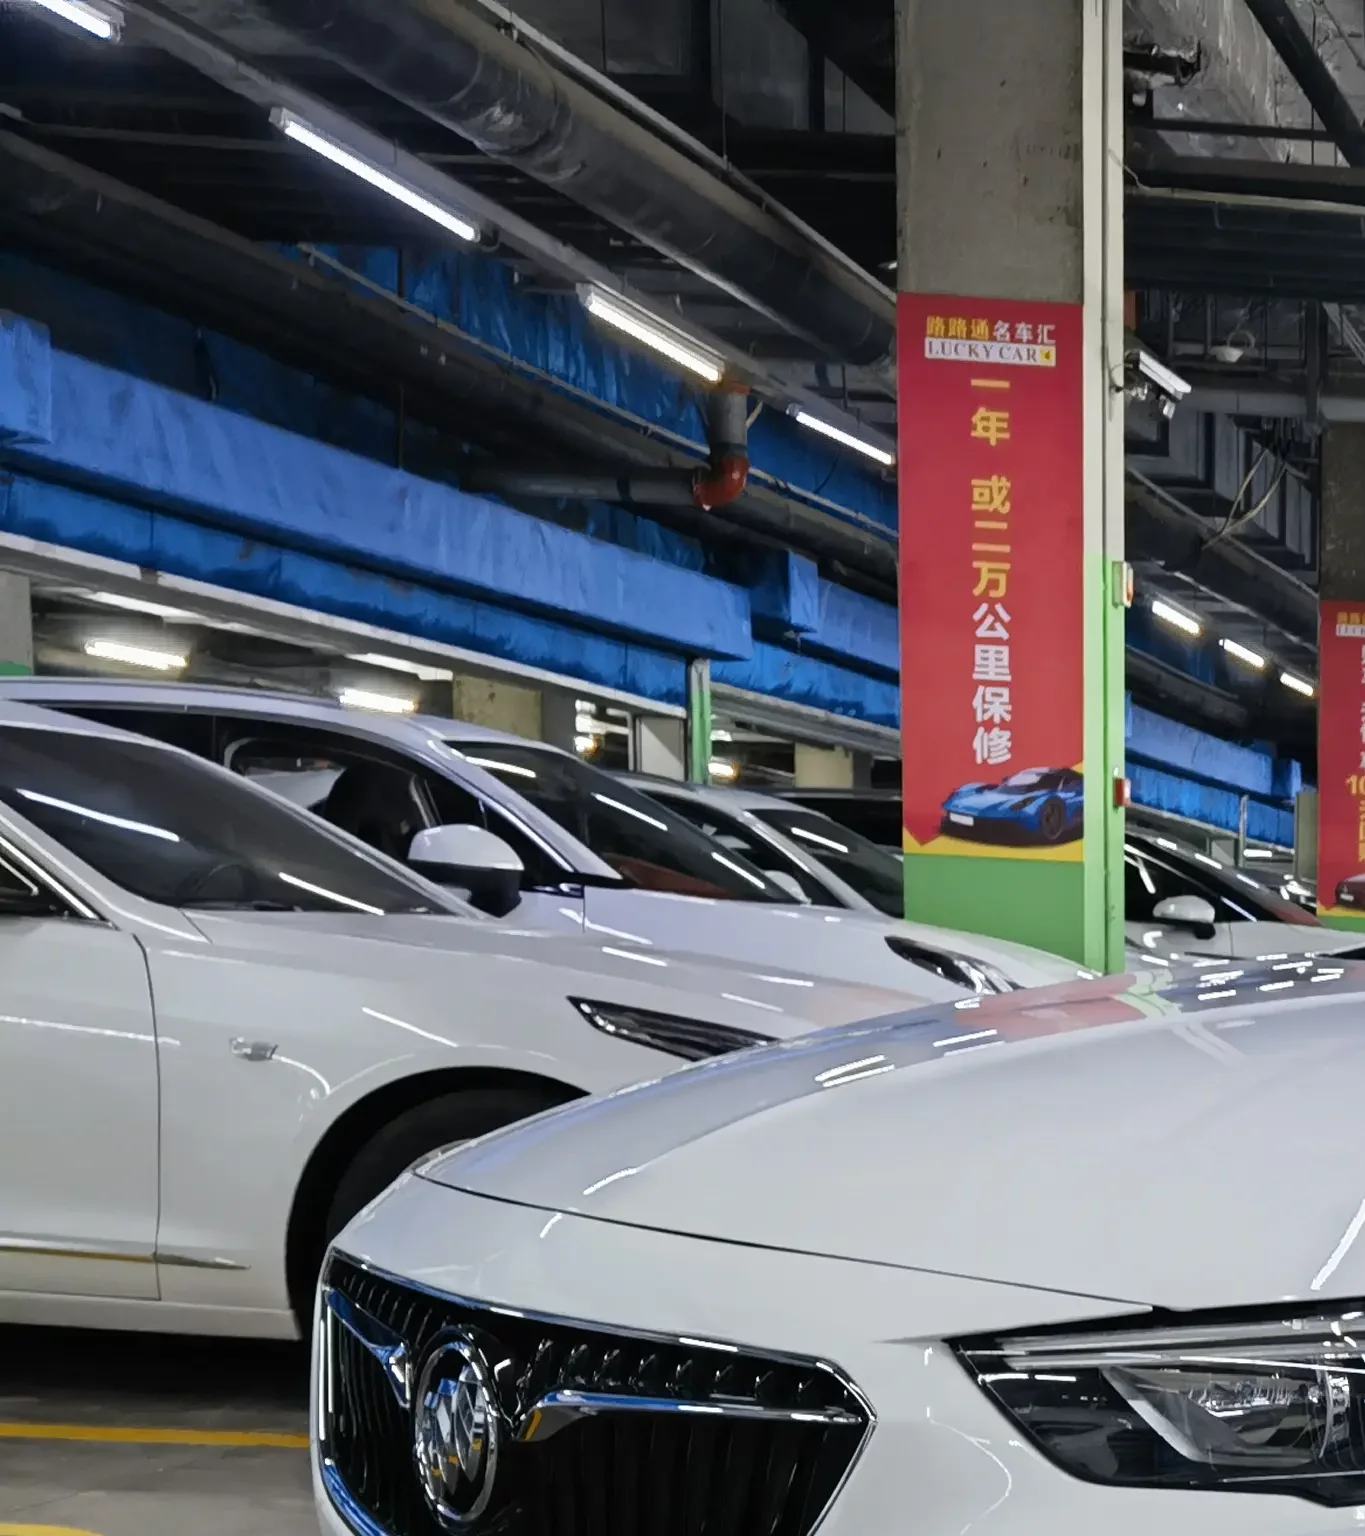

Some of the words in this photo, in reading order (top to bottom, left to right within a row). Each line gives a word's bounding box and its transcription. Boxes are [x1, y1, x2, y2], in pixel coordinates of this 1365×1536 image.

[926, 316, 1056, 344] 路路通名车汇
[928, 340, 994, 360] LUCKY
[999, 344, 1038, 364] CAR
